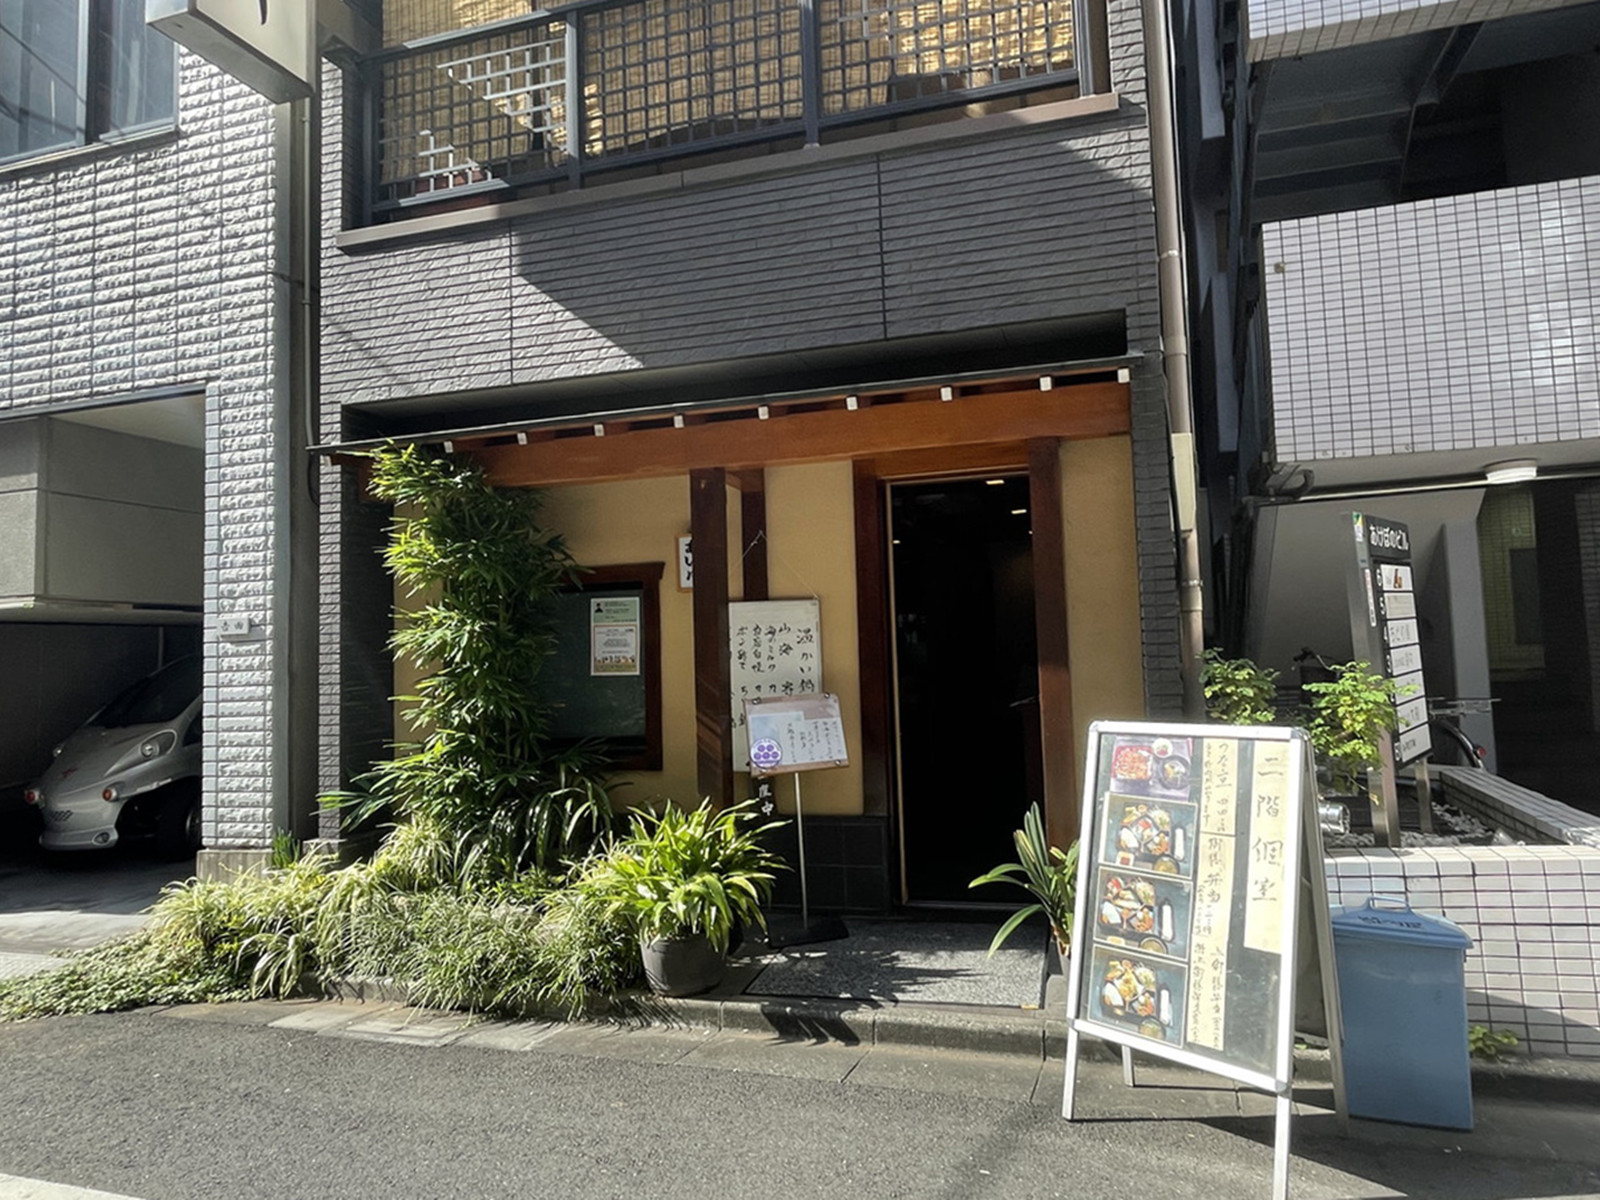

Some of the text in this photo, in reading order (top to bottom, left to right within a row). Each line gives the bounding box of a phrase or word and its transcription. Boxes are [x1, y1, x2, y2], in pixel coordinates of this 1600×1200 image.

[1369, 524, 1409, 551] あけぼのビル
[1376, 568, 1383, 587] 6
[1252, 757, 1284, 902] 二階個室
